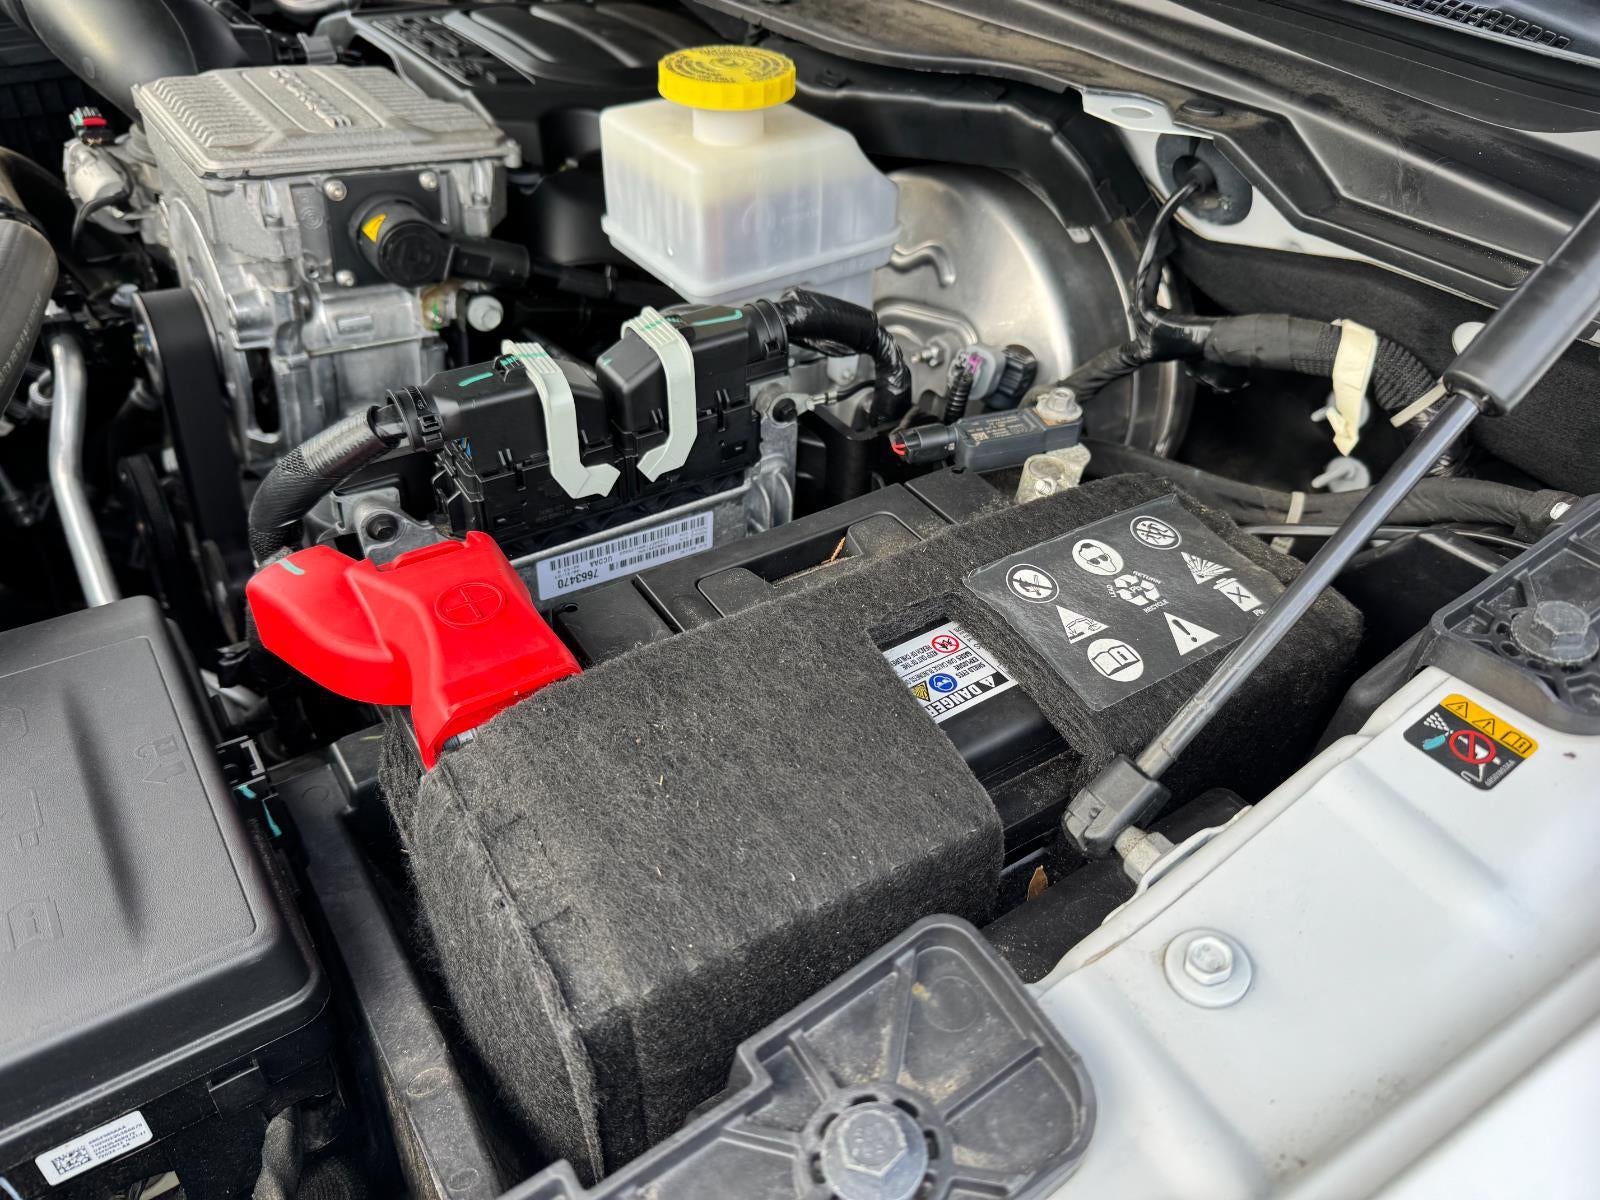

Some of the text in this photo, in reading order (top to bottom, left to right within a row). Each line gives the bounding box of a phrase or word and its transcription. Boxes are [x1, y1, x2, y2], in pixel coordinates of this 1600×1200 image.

[558, 569, 598, 590] 7663470
[1132, 570, 1161, 584] RETURN
[1106, 584, 1117, 598] LEAD
[1142, 599, 1170, 614] RECYCLE
[915, 644, 932, 654] REACH
[925, 650, 938, 659] KEEP
[956, 650, 973, 660] GASES
[901, 662, 913, 670] THE
[932, 662, 948, 672] CAUSE
[953, 656, 978, 670] EXPLOSIVE
[956, 661, 986, 678] SHIELD EYES
[924, 684, 982, 717] DANGER
